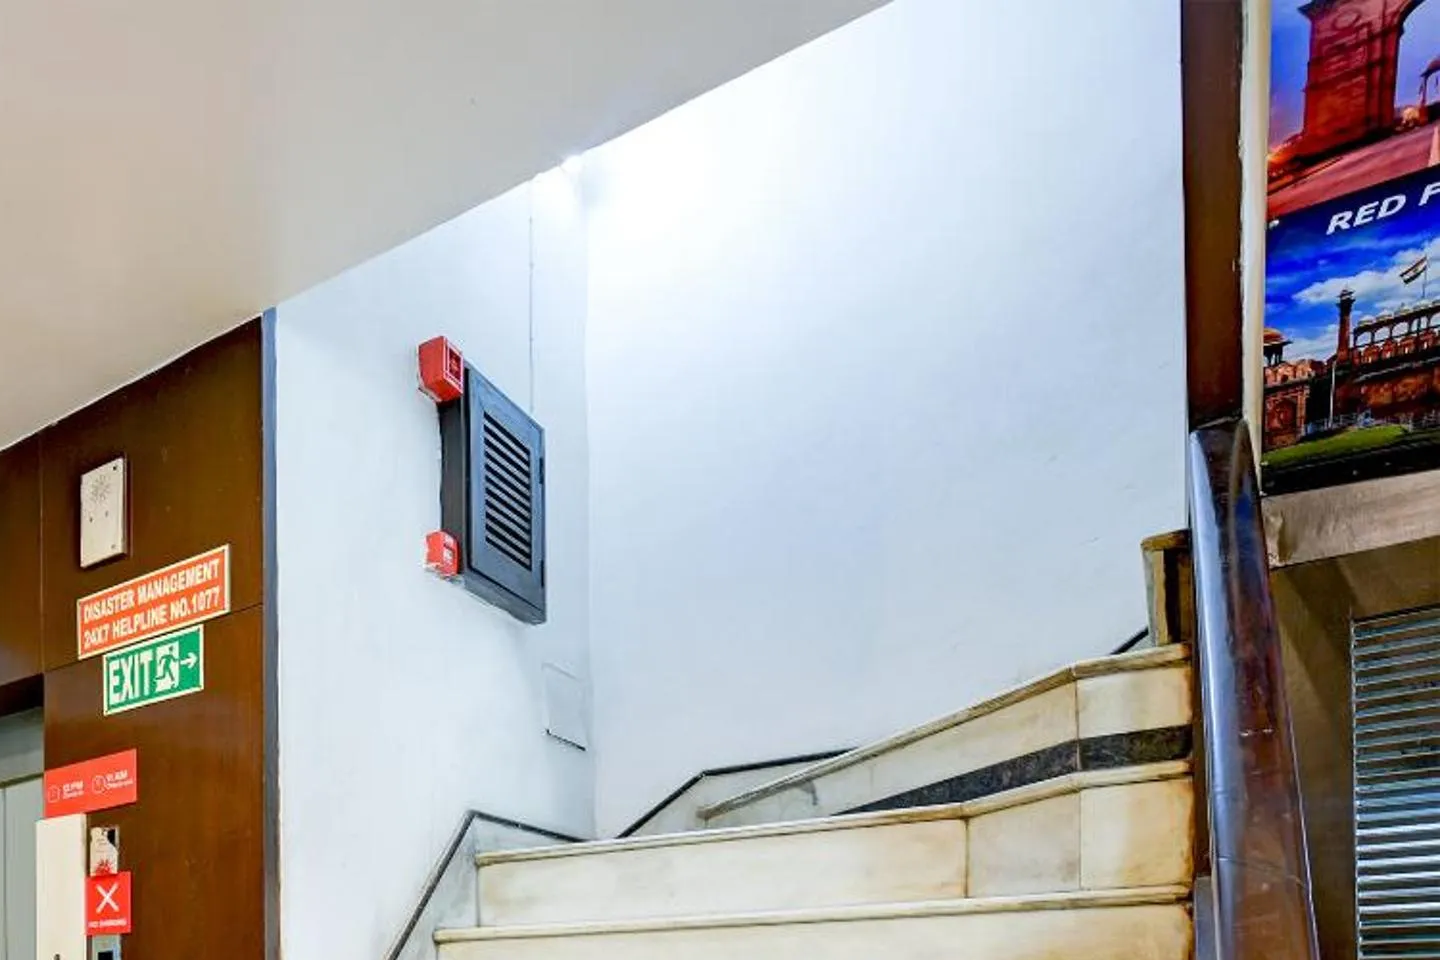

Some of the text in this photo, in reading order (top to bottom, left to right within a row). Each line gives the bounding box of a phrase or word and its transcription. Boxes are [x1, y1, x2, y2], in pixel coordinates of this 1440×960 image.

[1326, 194, 1406, 235] RED
[84, 559, 220, 623] DISASTER MANAGEMENT
[84, 627, 109, 649] 24X7
[112, 605, 167, 639] HELPLINE
[109, 650, 153, 705] EXIT
